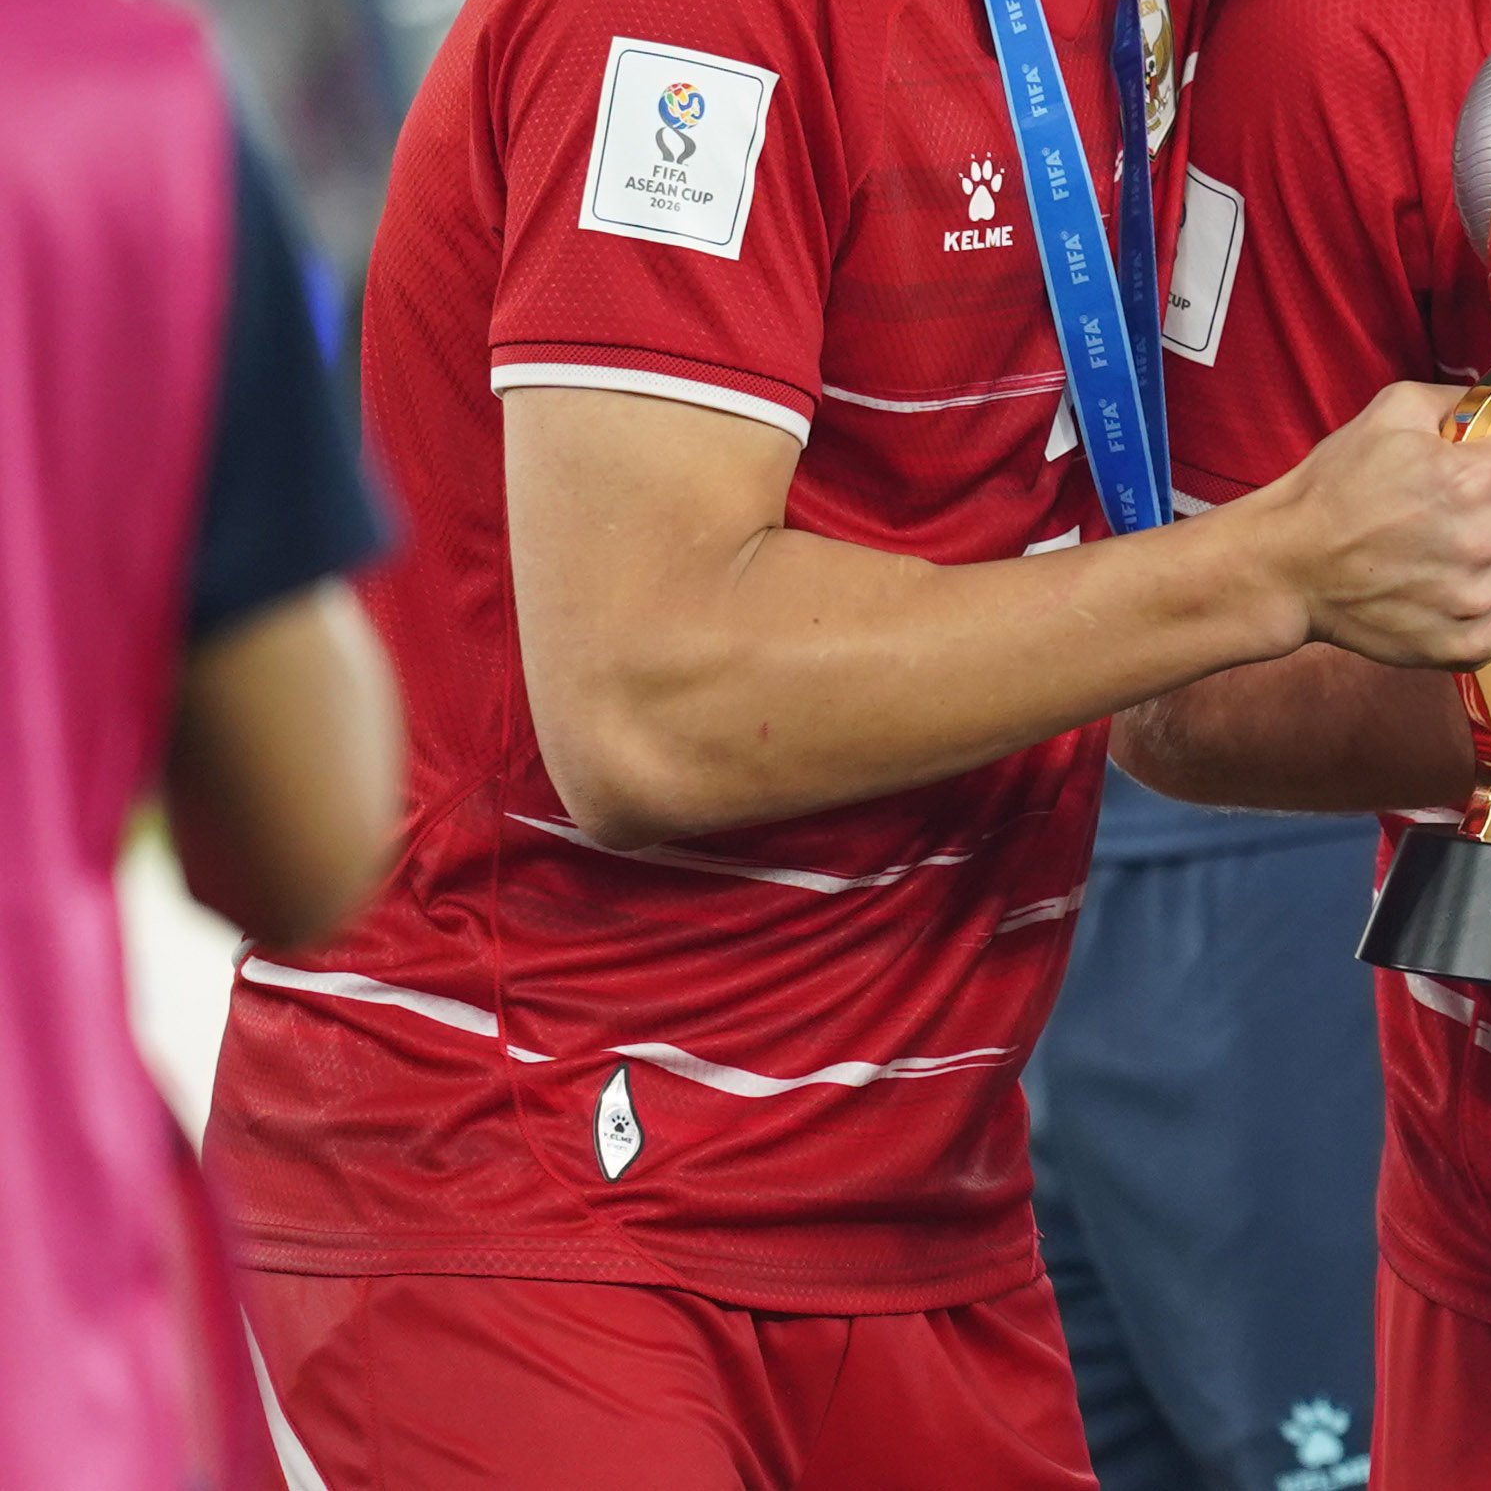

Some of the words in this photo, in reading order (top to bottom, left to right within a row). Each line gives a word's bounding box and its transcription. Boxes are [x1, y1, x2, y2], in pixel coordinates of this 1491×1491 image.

[1024, 66, 1048, 118] FIFA
[625, 176, 678, 197] ASEAN
[682, 187, 714, 205] CUP
[652, 165, 687, 184] FIFA
[1047, 149, 1070, 201] FIFA
[650, 197, 681, 212] 2026
[943, 225, 1014, 252] KELME
[1067, 234, 1091, 286] FIFA
[1083, 317, 1109, 370] FIFA
[1101, 402, 1126, 454] FIFA
[603, 1131, 634, 1145] ELME
